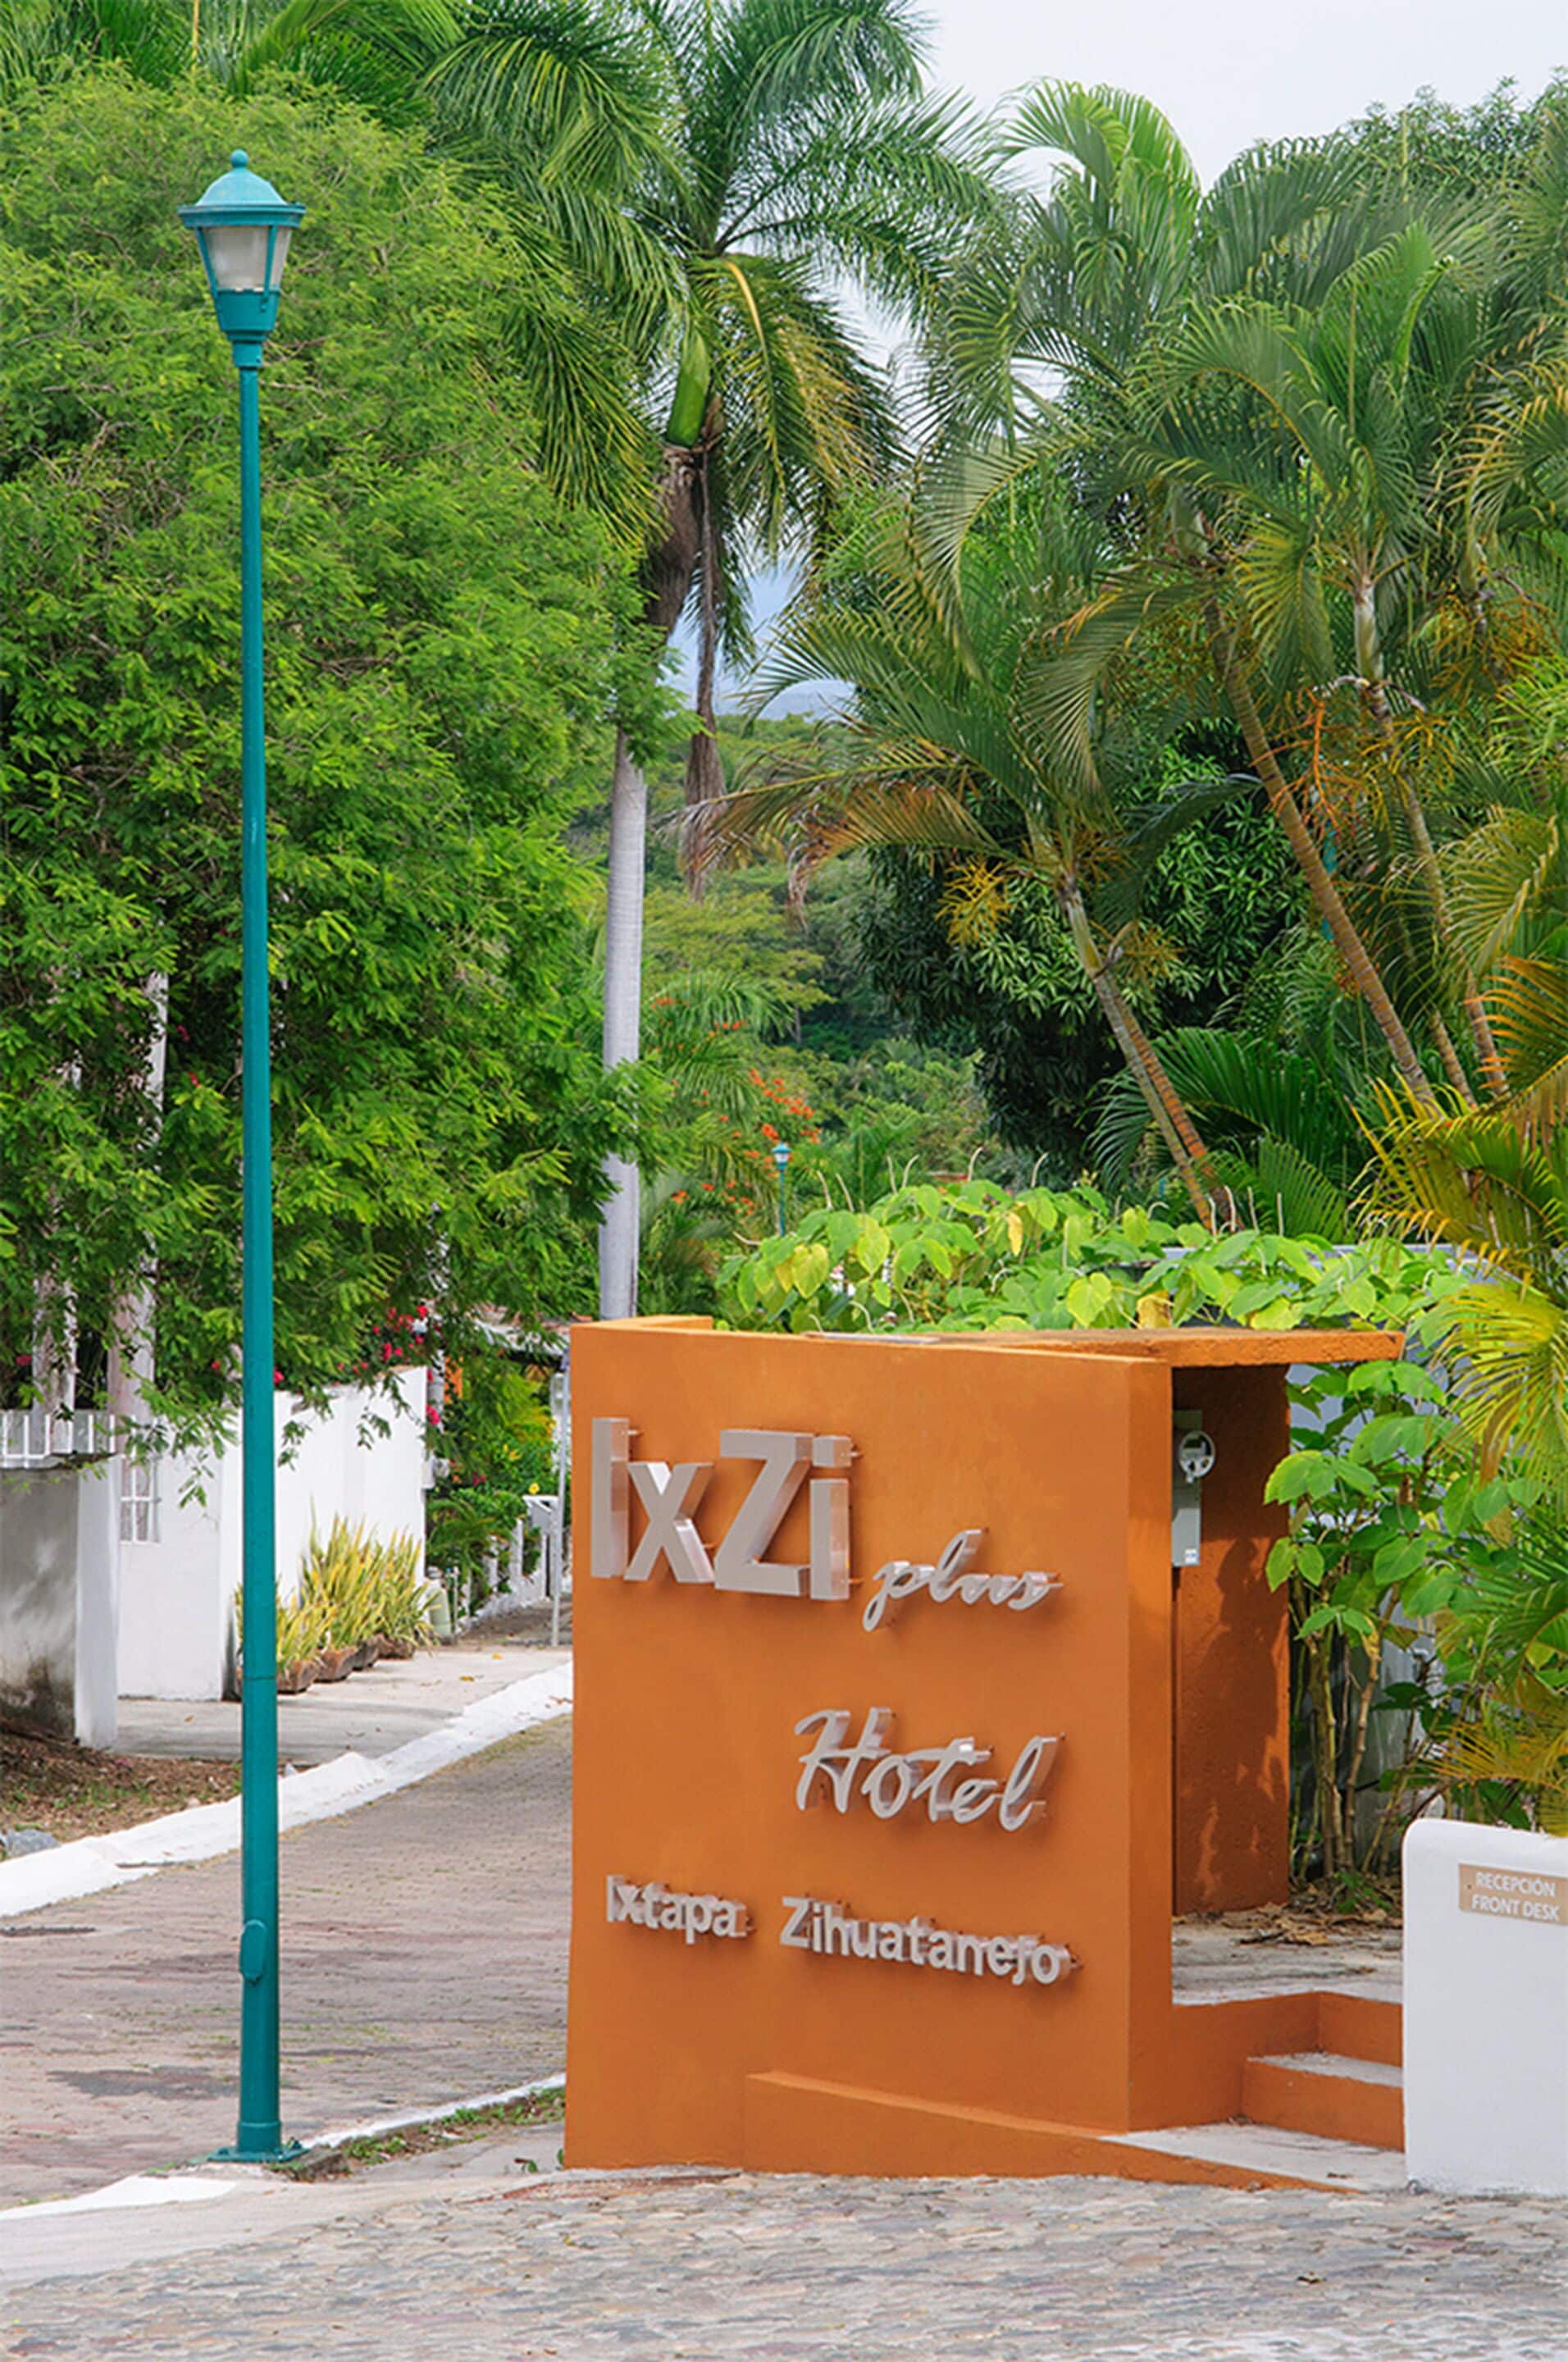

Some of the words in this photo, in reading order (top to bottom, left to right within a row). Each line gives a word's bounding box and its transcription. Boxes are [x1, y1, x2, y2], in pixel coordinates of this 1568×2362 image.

[590, 1418, 851, 1600] IxZi
[862, 1530, 1064, 1632] plus
[793, 1706, 1058, 1831] Hotel
[607, 1875, 747, 1945] Ixtapa
[780, 1896, 1072, 1986] Zihuatanejo
[1472, 1895, 1520, 1915] FRONT
[1523, 1901, 1559, 1921] DESK
[1476, 1872, 1556, 1897] RECEPCIÓN
